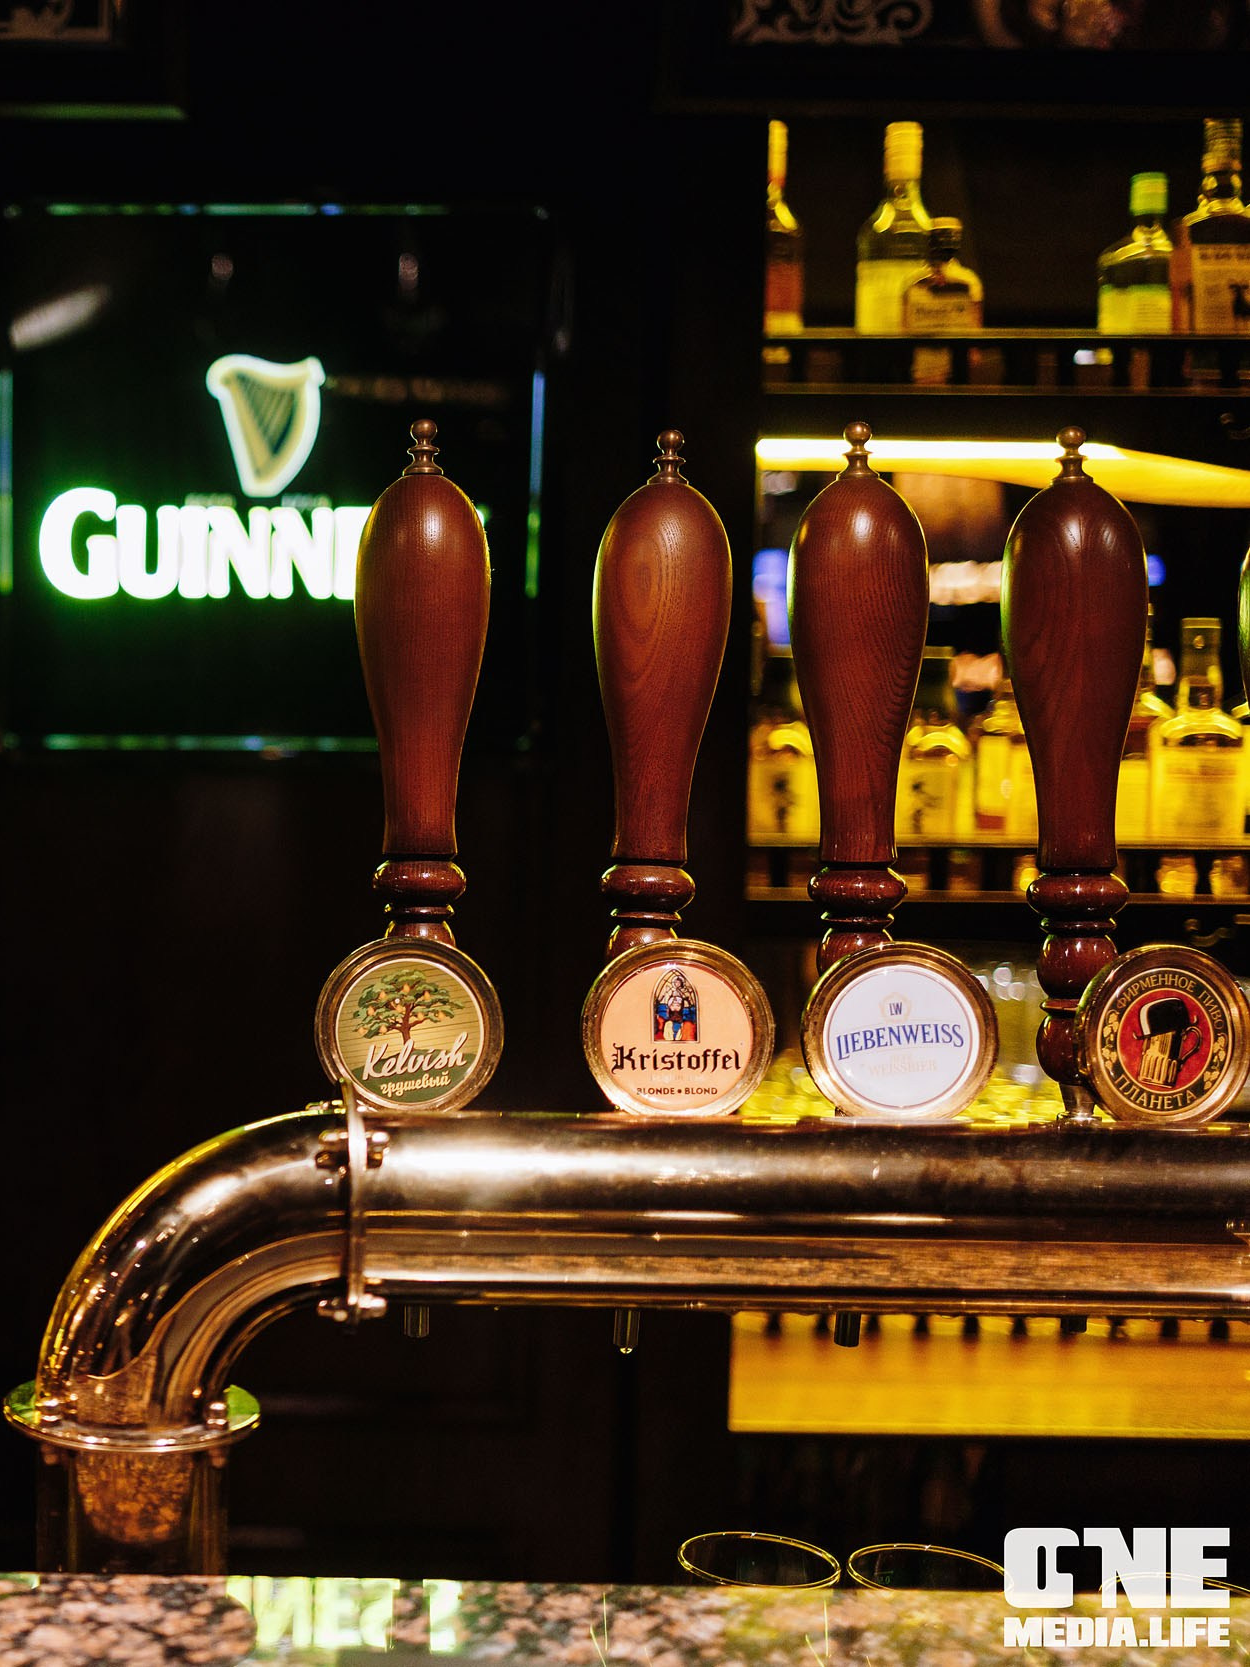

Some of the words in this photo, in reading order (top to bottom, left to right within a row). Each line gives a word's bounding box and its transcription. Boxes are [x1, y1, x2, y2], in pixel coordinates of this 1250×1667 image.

[38, 486, 488, 600] GUINN
[889, 1002, 903, 1016] LW
[1116, 973, 1197, 1010] ФИРМЕННОЕ
[1198, 989, 1225, 1030] ПИВО
[362, 1031, 468, 1081] Kelvish
[611, 1042, 742, 1075] Kristoffel
[836, 1023, 964, 1060] LIEBENWEISS
[380, 1070, 451, 1098] грушевый
[636, 1087, 675, 1096] BLONDE
[684, 1087, 718, 1096] BLOND
[1114, 1074, 1197, 1110] ПЛАНЕТА
